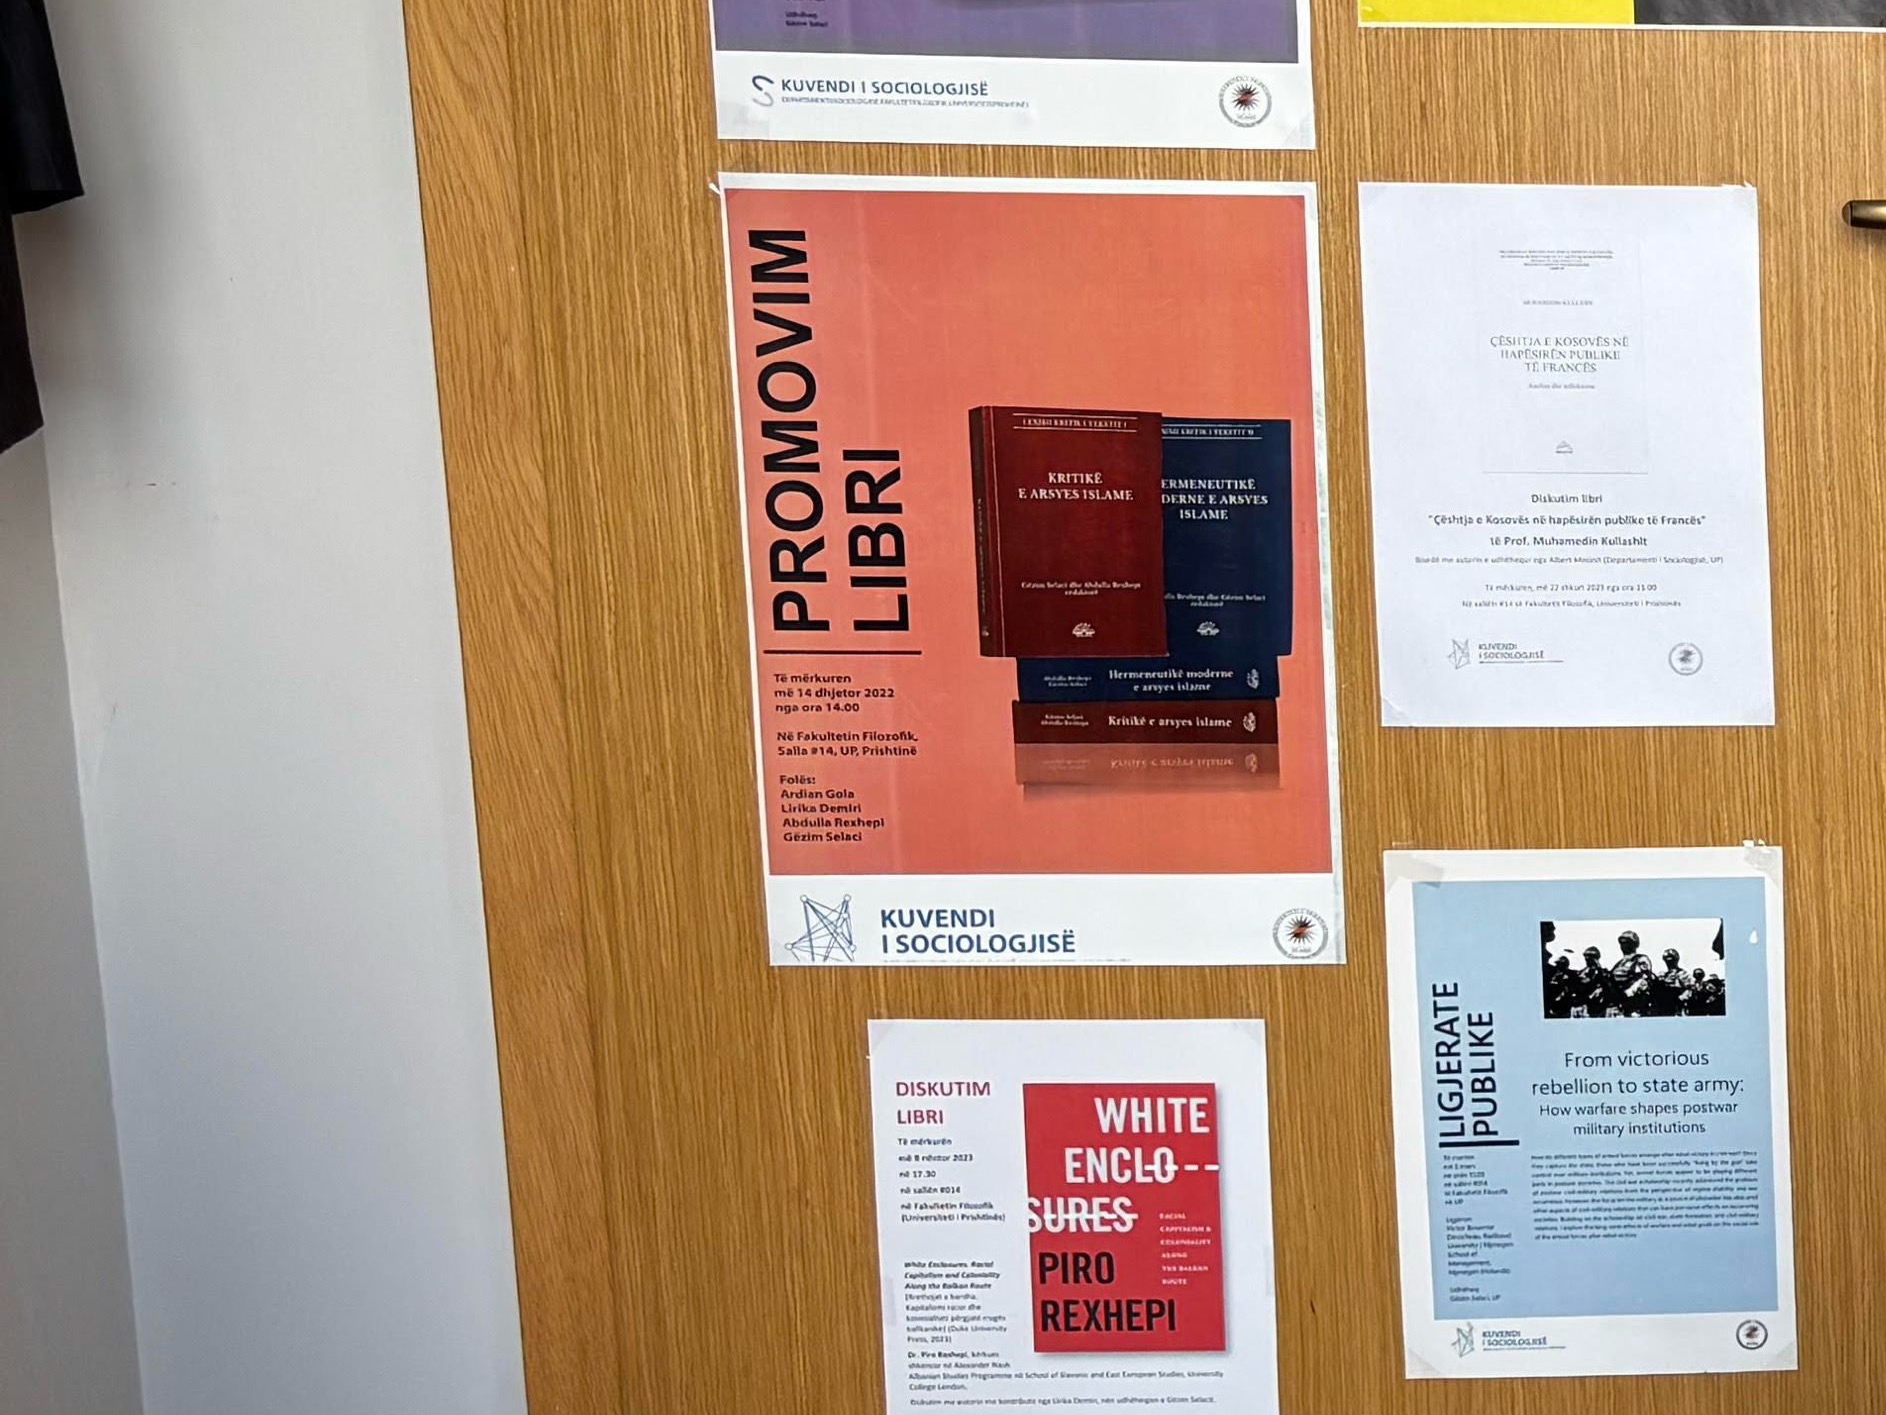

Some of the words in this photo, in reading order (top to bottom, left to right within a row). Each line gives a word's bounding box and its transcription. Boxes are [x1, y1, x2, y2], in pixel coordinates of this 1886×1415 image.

[782, 79, 855, 93] KUVENDI
[861, 81, 865, 93] I
[872, 81, 988, 96] SOCIOLOGJISË
[748, 230, 830, 631] PROMOVIM
[1048, 472, 1102, 484] KRITIKË
[1161, 478, 1256, 490] ERMENEUTIKË
[1019, 488, 1026, 498] E
[1030, 488, 1079, 500] ARSYES
[1083, 490, 1133, 501] ISLAME
[1162, 494, 1205, 504] DERNE
[1209, 494, 1216, 504] E
[1220, 494, 1268, 505] ARSYES
[1531, 494, 1578, 504] Diskutim
[1582, 494, 1602, 504] libri
[1179, 509, 1228, 519] ISLAME
[842, 449, 909, 632] LIBRI
[1490, 537, 1501, 546] të
[1504, 537, 1530, 547] Prof.
[1533, 537, 1598, 546] Muhamedin
[774, 673, 788, 683] Të
[790, 674, 851, 683] mërkuren
[774, 688, 794, 698] më
[798, 688, 812, 697] 14
[815, 688, 861, 699] dhjetor
[864, 688, 894, 698] 2022
[776, 704, 799, 714] nga
[802, 704, 822, 712] ora
[827, 703, 859, 712] 14.00
[777, 732, 794, 741] Në
[797, 731, 860, 741] Fakultetin
[778, 746, 808, 756] Salla
[840, 746, 859, 757] UP,
[862, 746, 917, 756] Prishtinë
[780, 775, 815, 784] Folës:
[781, 789, 823, 799] Ardian
[826, 789, 855, 799] Gola
[781, 804, 816, 813] Lirika
[820, 804, 861, 813] Demiri
[783, 818, 831, 827] Abdulla
[835, 818, 884, 829] Rexhepi
[784, 832, 823, 842] Gëzim
[826, 832, 862, 841] Selaci
[881, 909, 995, 928] KUVENDI
[882, 935, 888, 953] I
[896, 929, 1075, 953] SOCIOLOGJISË
[1432, 983, 1465, 1137] LIGJERATE
[1565, 1053, 1612, 1068] From
[1618, 1050, 1709, 1067] victorious
[1468, 1012, 1498, 1136] PUBLIKE
[896, 1082, 990, 1096] DISKUTIM
[1532, 1078, 1612, 1095] rebellion
[1618, 1079, 1637, 1094] to
[1643, 1078, 1688, 1093] state
[1694, 1078, 1744, 1096] army:
[1094, 1097, 1210, 1133] WHITE
[1540, 1105, 1571, 1116] How
[1575, 1103, 1626, 1115] warfare
[1630, 1103, 1678, 1116] shapes
[1683, 1102, 1738, 1116] postwar
[897, 1110, 943, 1124] LIBRI
[1574, 1122, 1624, 1137] military
[1629, 1121, 1705, 1134] institutions
[1028, 1197, 1134, 1233] SURES
[1039, 1251, 1114, 1284] PIRO
[1041, 1299, 1175, 1331] REXHEPI
